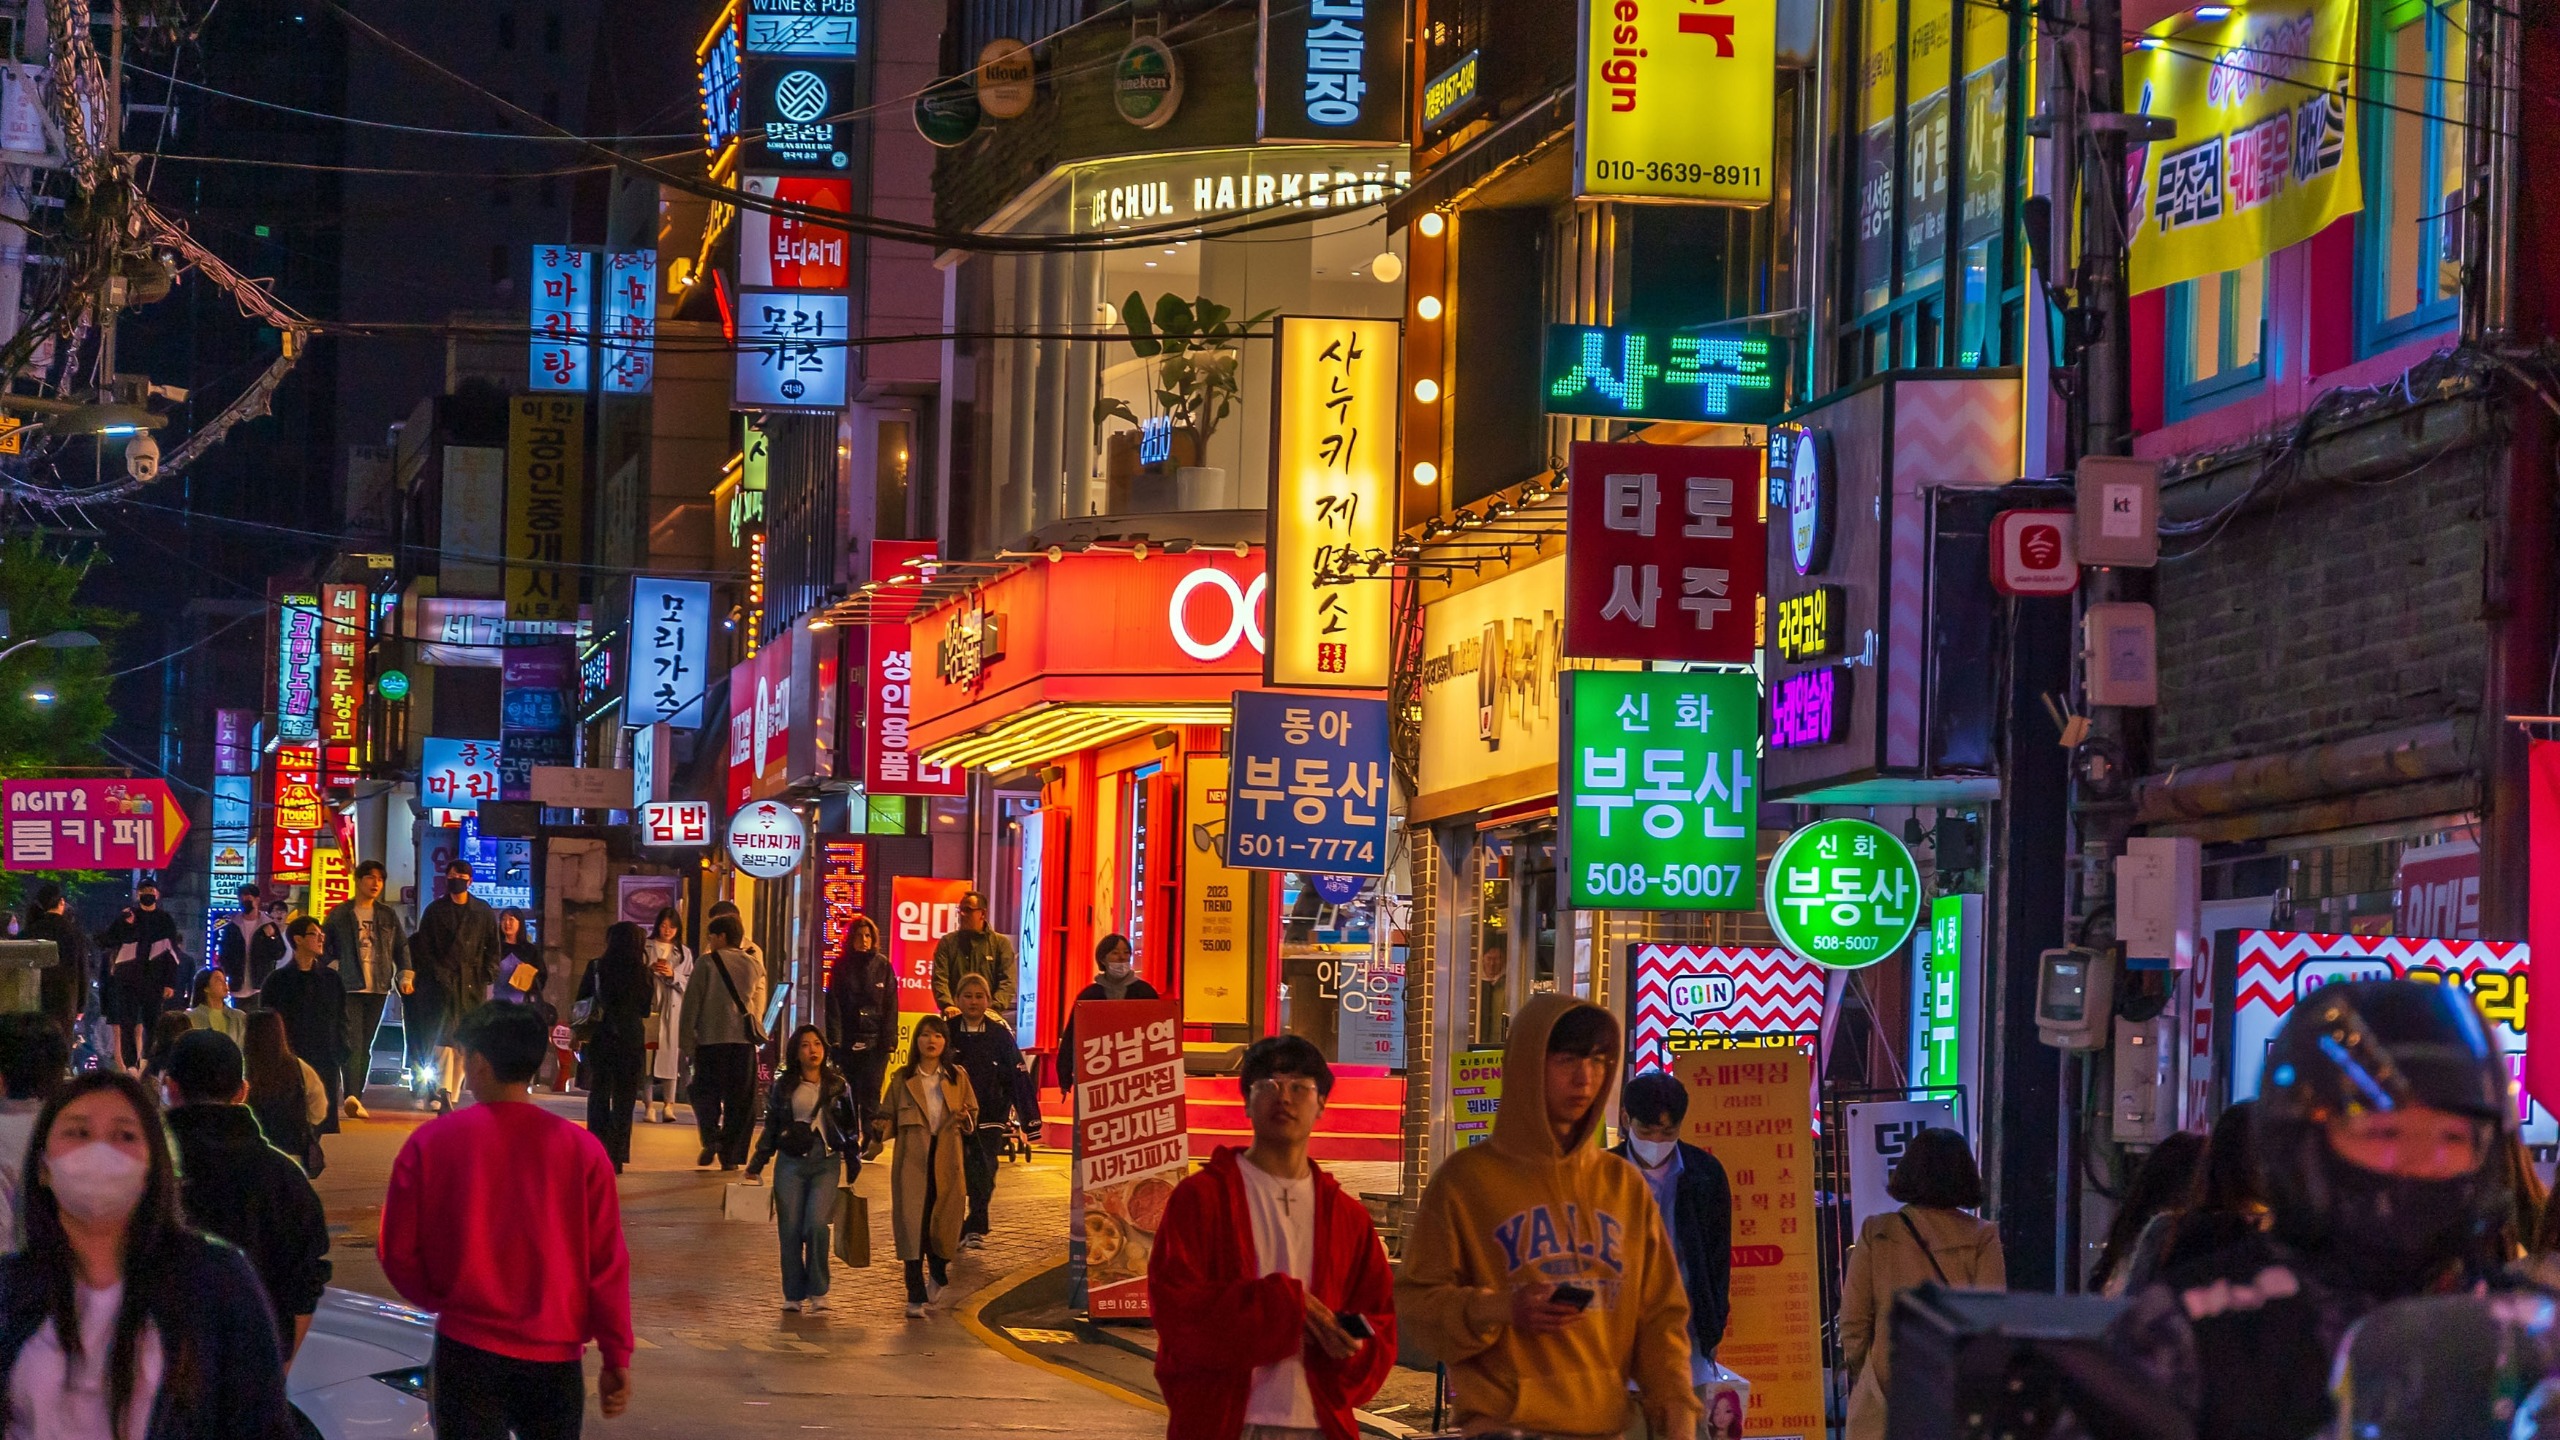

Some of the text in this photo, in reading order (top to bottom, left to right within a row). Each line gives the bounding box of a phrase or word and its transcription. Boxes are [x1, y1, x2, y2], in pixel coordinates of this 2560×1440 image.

[753, 0, 801, 11] WINE
[822, 0, 855, 12] PUB
[1596, 160, 1761, 186] 010-3639-8911
[2154, 137, 2224, 234] 무조건
[1111, 181, 1174, 222] CHUL
[774, 235, 842, 268] 부대찌개
[542, 272, 578, 385] 마라탕
[762, 306, 823, 336] 모리
[783, 384, 802, 394] 지하
[1552, 332, 1771, 414] 사주
[1604, 473, 1734, 539] 타로
[1794, 472, 1816, 515] LALA
[2113, 498, 2131, 512] kt
[522, 427, 566, 601] 공인중개사
[1600, 565, 1732, 630] 사주
[1778, 588, 1827, 659] 라라코인
[330, 590, 356, 740] 세계맥주창고
[653, 594, 689, 716] 모리가츠
[1615, 693, 1714, 733] 신화
[1772, 671, 1835, 746] 노래연습장
[1281, 708, 1352, 747] 동아
[11, 789, 87, 812] AGIT 2
[1239, 755, 1383, 826] 부동산
[1576, 748, 1752, 838] 부동산
[283, 810, 316, 821] TOUCH
[650, 806, 706, 841] 김밥
[12, 820, 154, 861] 룸카페
[732, 833, 801, 850] 부대찌개
[1239, 833, 1374, 863] 501-7774
[1815, 834, 1878, 860] 신화
[741, 853, 791, 868] 철판구이
[1207, 886, 1229, 898] 2023
[1586, 863, 1742, 897] 508-5007
[1783, 867, 1910, 926] 부동산
[1203, 901, 1232, 912] TREND
[1813, 936, 1879, 950] 508-5007
[1675, 982, 1727, 1006] COIN
[1083, 1019, 1176, 1075] 강남역
[1375, 1040, 1390, 1053] 10
[1086, 1064, 1176, 1113] 피자맛집
[1460, 1068, 1501, 1081] OPEN
[1693, 1062, 1789, 1087] 슈퍼왁싱
[1087, 1104, 1176, 1152] 오리지널
[1695, 1118, 1793, 1137] 브라질리언
[1089, 1138, 1183, 1185] 시카고피자
[1494, 1202, 1623, 1276] YALE
[1098, 1300, 1117, 1310] 문의
